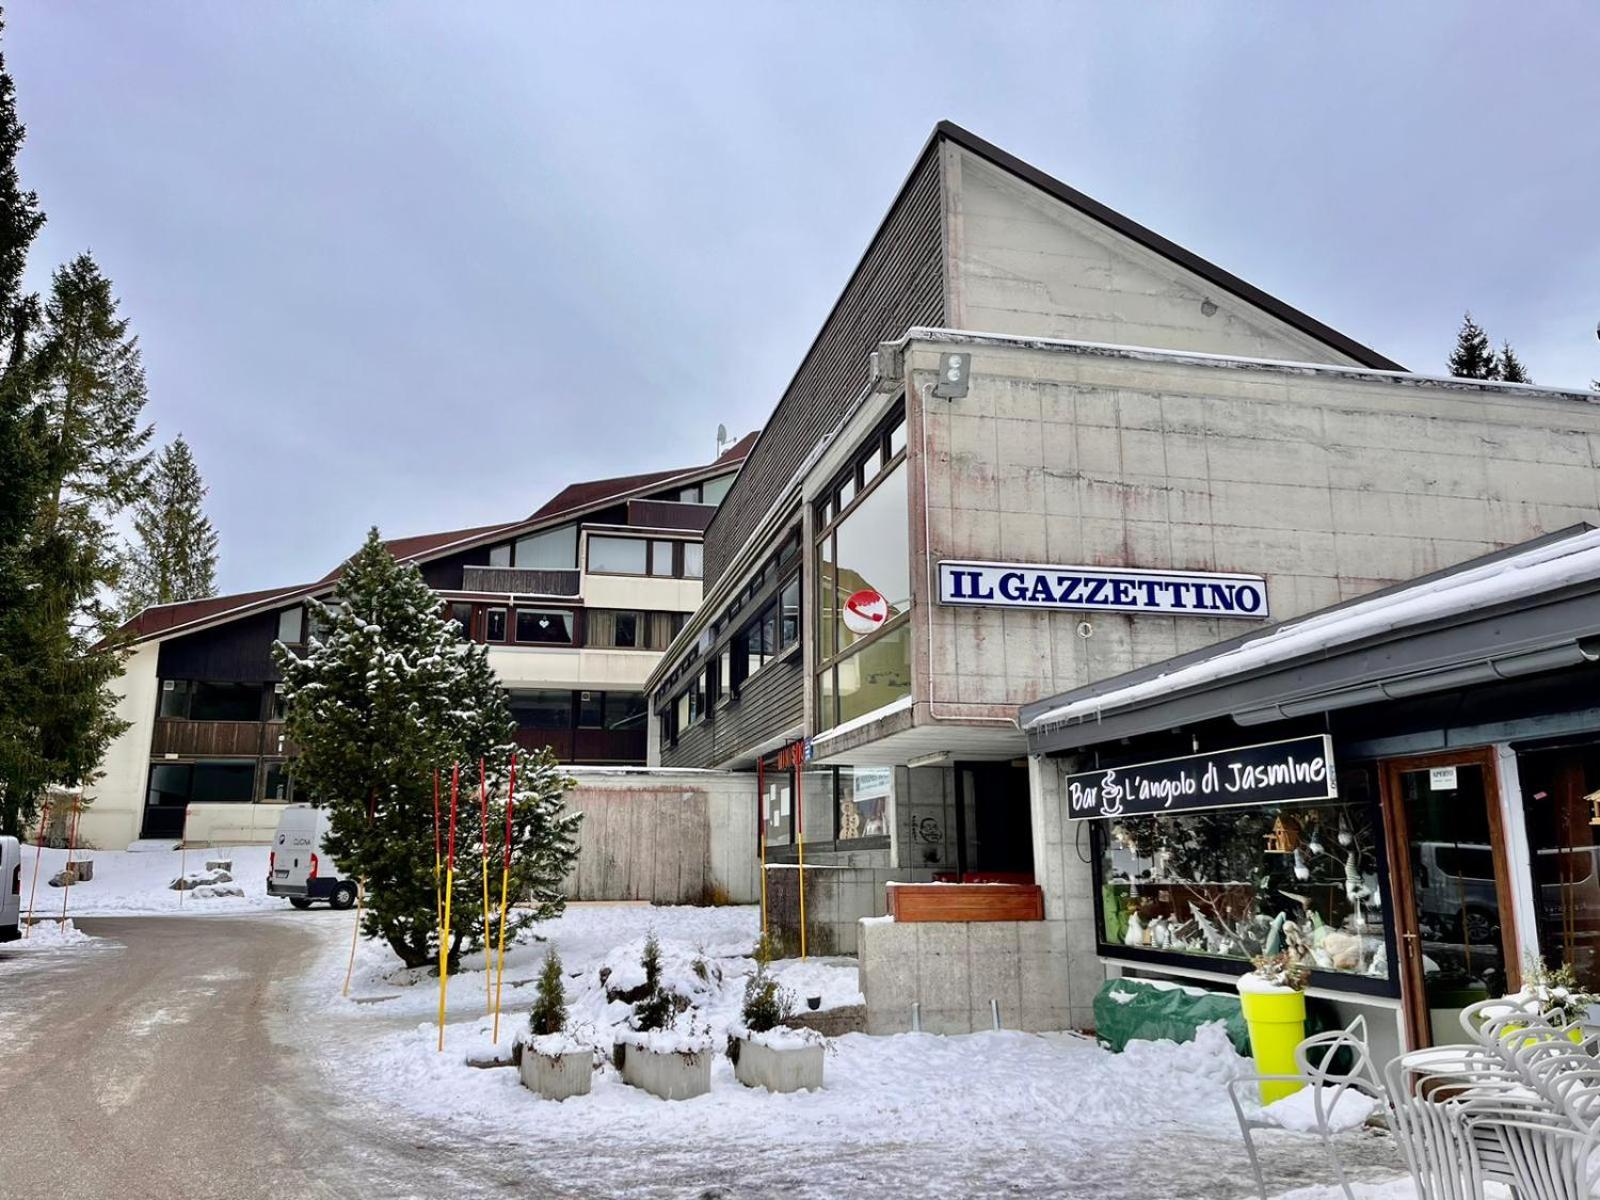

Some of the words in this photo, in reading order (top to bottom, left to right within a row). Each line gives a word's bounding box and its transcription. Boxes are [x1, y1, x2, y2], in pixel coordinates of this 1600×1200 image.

[950, 570, 994, 599] IL
[998, 572, 1261, 612] GAZZETTINO
[1069, 781, 1098, 811] Bar
[1125, 771, 1196, 808] L'angolo
[1202, 761, 1219, 794] di
[1224, 756, 1326, 793] Jasmine
